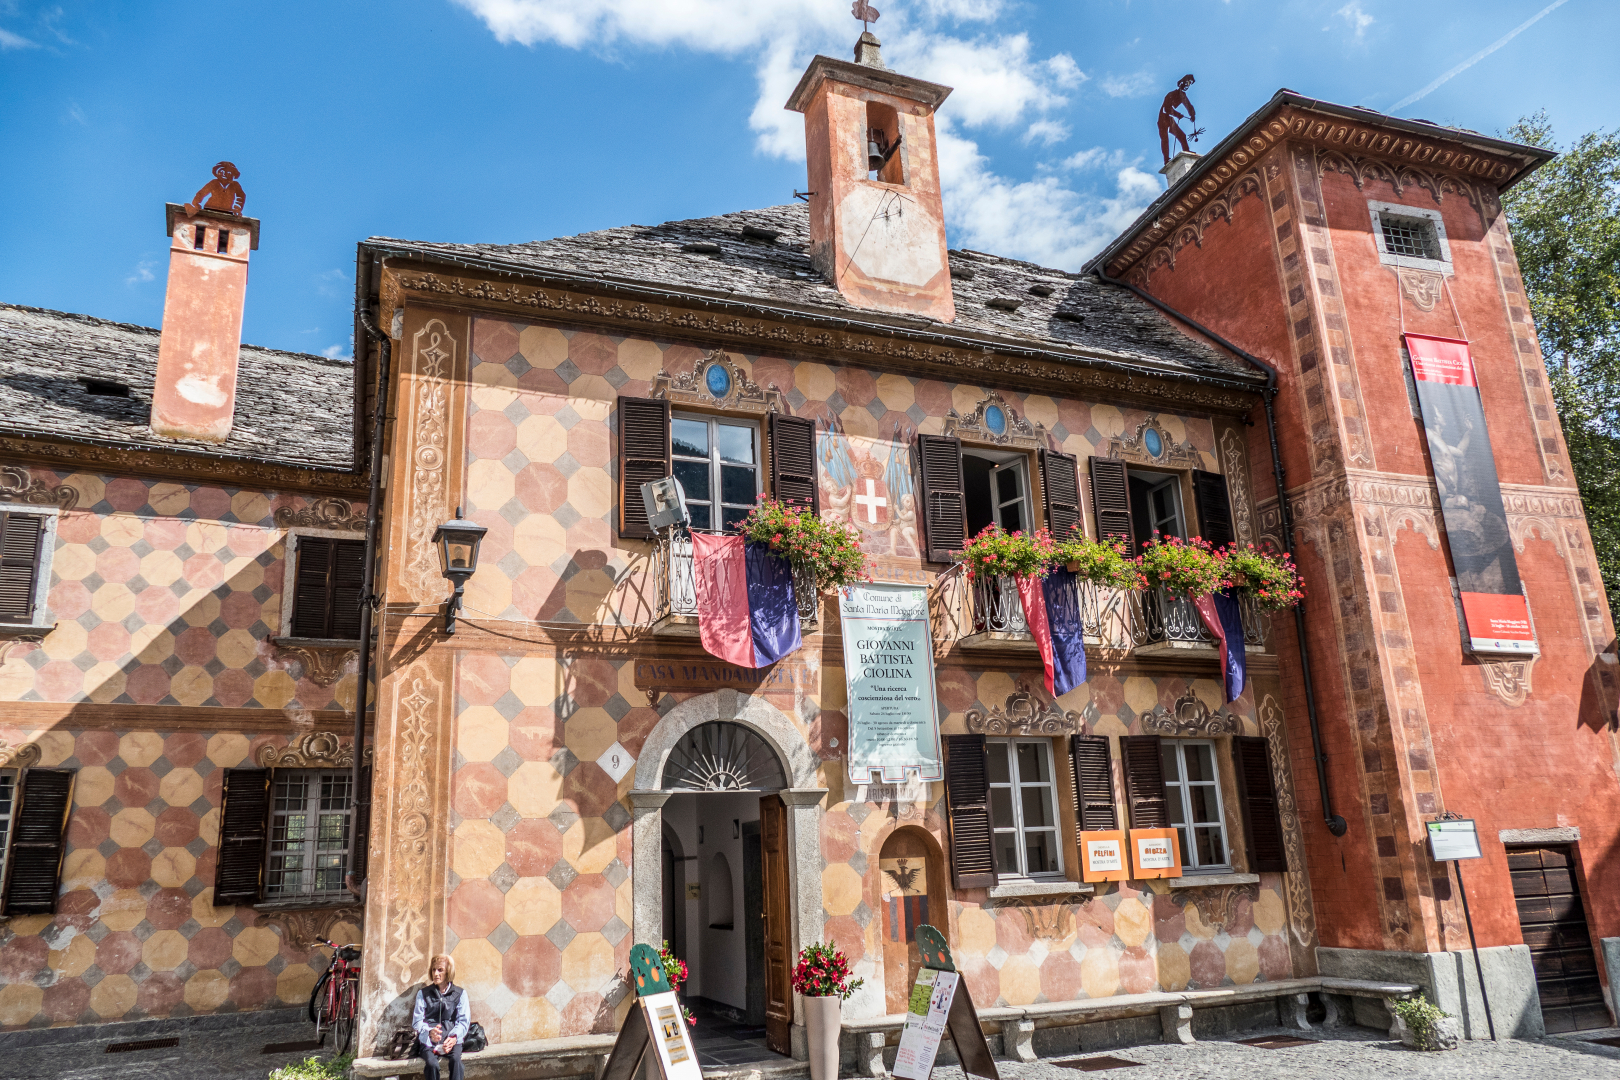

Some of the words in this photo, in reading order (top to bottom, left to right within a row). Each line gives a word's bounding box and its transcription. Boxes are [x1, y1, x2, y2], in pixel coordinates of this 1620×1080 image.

[863, 591, 893, 602] Comune
[895, 593, 902, 602] di
[843, 603, 864, 614] Santa
[866, 604, 889, 614] Maria
[890, 605, 925, 617] Maggiore
[856, 640, 915, 651] GIOVANNI
[860, 654, 914, 665] BATTISTA
[637, 664, 676, 680] CASA
[863, 668, 912, 679] CIOLINA
[611, 754, 620, 769] 9
